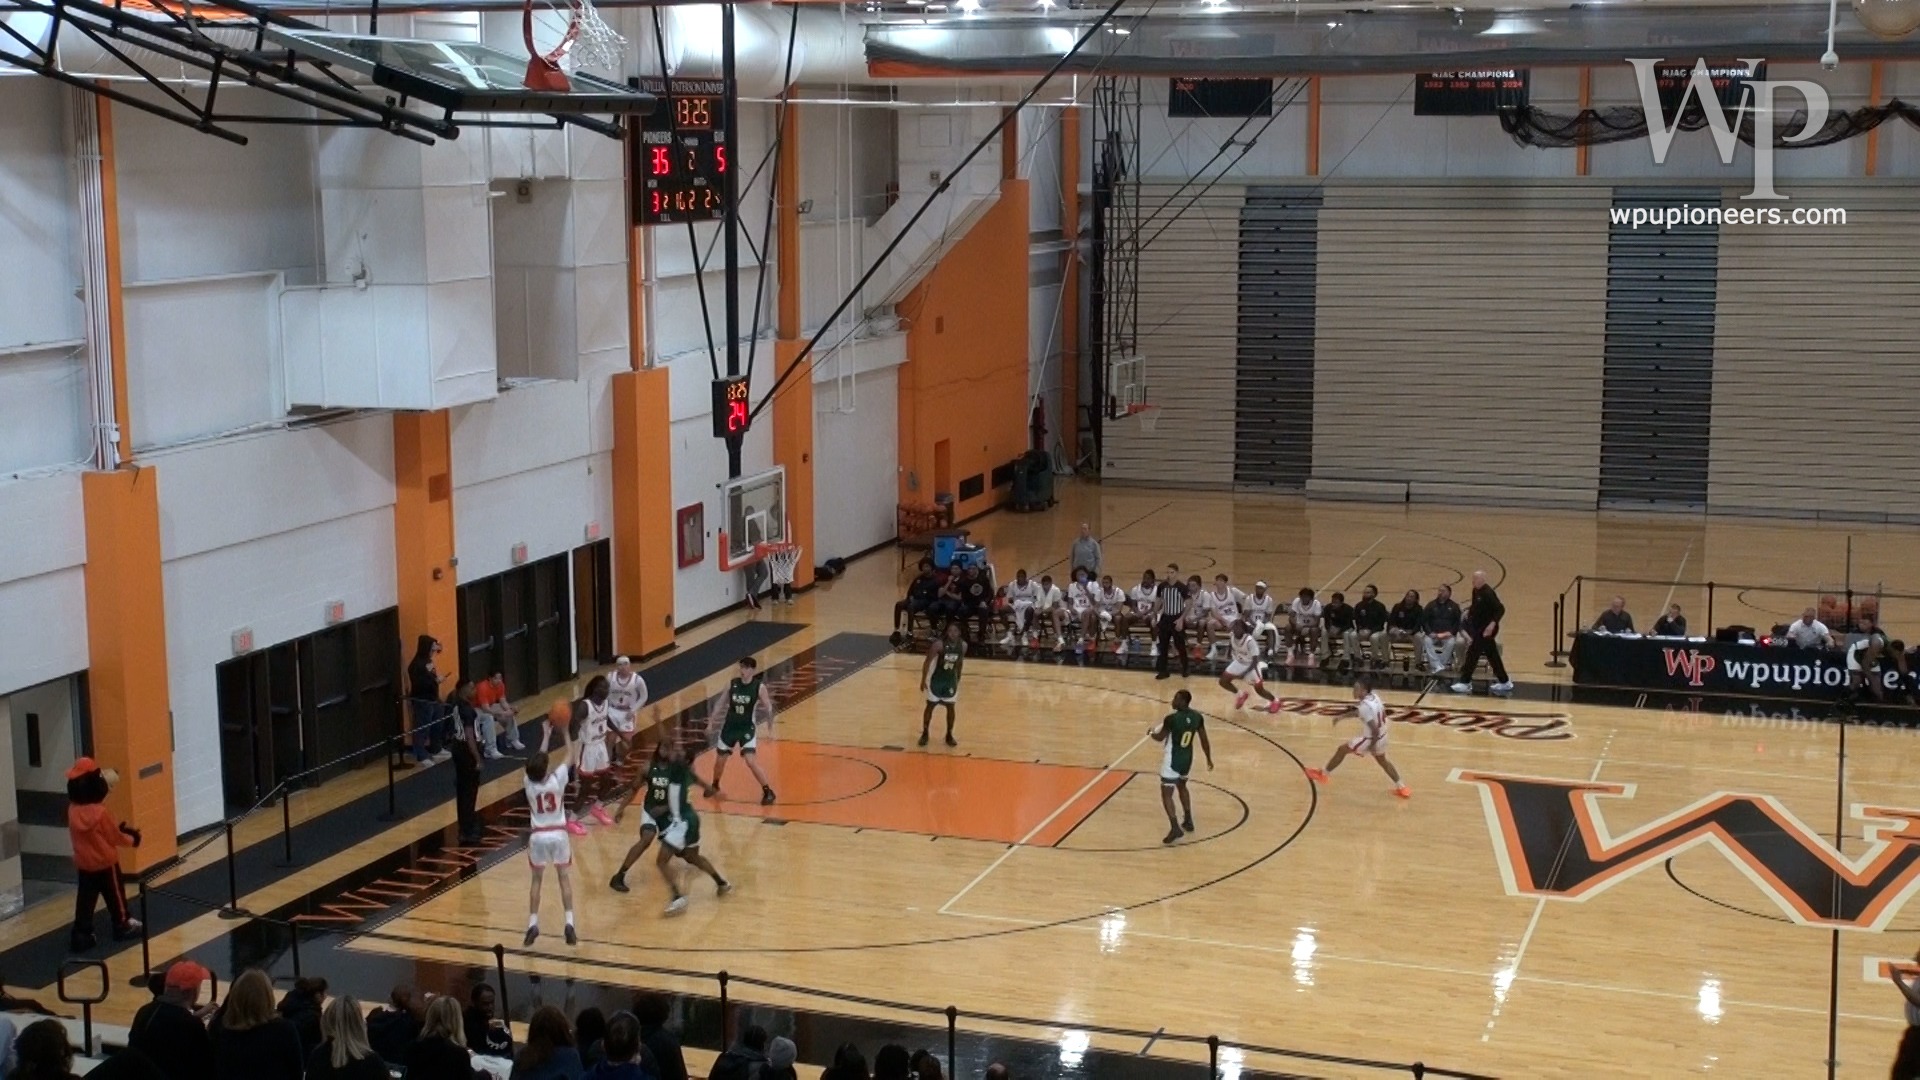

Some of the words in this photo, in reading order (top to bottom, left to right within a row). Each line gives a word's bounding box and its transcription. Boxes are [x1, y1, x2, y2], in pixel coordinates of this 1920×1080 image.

[642, 80, 667, 93] WILLIA
[643, 131, 673, 144] PIONEERS
[651, 147, 669, 175] 35
[728, 401, 746, 431] 24
[1662, 647, 1716, 687] WP
[535, 791, 557, 814] 13
